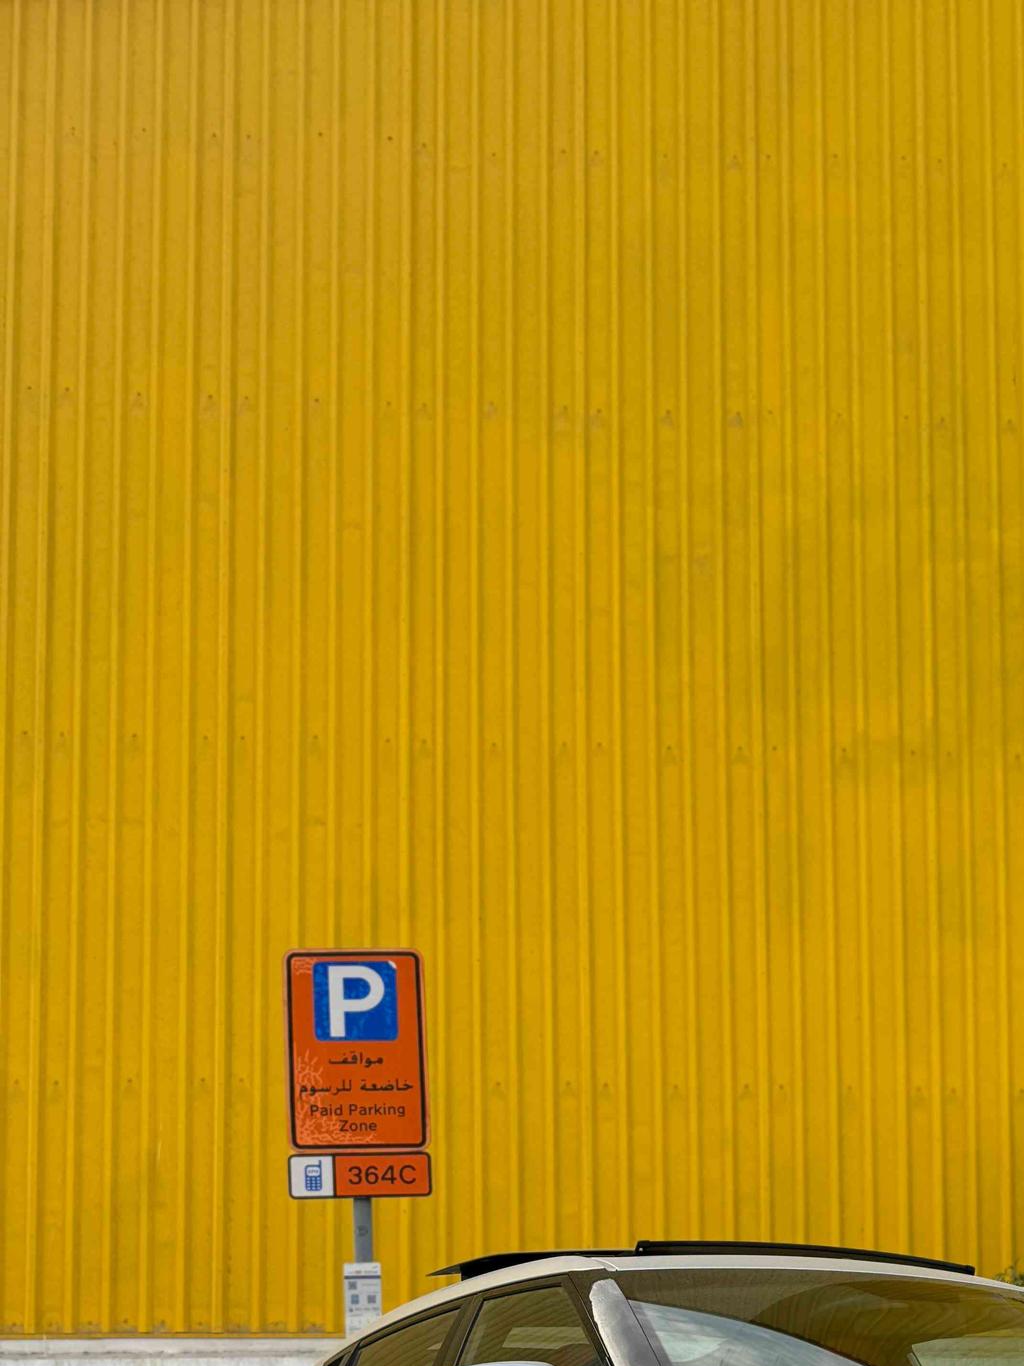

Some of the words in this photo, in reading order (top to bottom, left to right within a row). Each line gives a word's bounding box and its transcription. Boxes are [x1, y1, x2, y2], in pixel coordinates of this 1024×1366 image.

[328, 965, 385, 1038] P
[328, 1051, 384, 1068] مواقف
[300, 1079, 353, 1098] للرسوم
[360, 1078, 413, 1092] خاضعة
[310, 1104, 343, 1117] Paid
[348, 1103, 406, 1118] Parking
[339, 1119, 378, 1132] Zone
[347, 1164, 417, 1185] 364C
